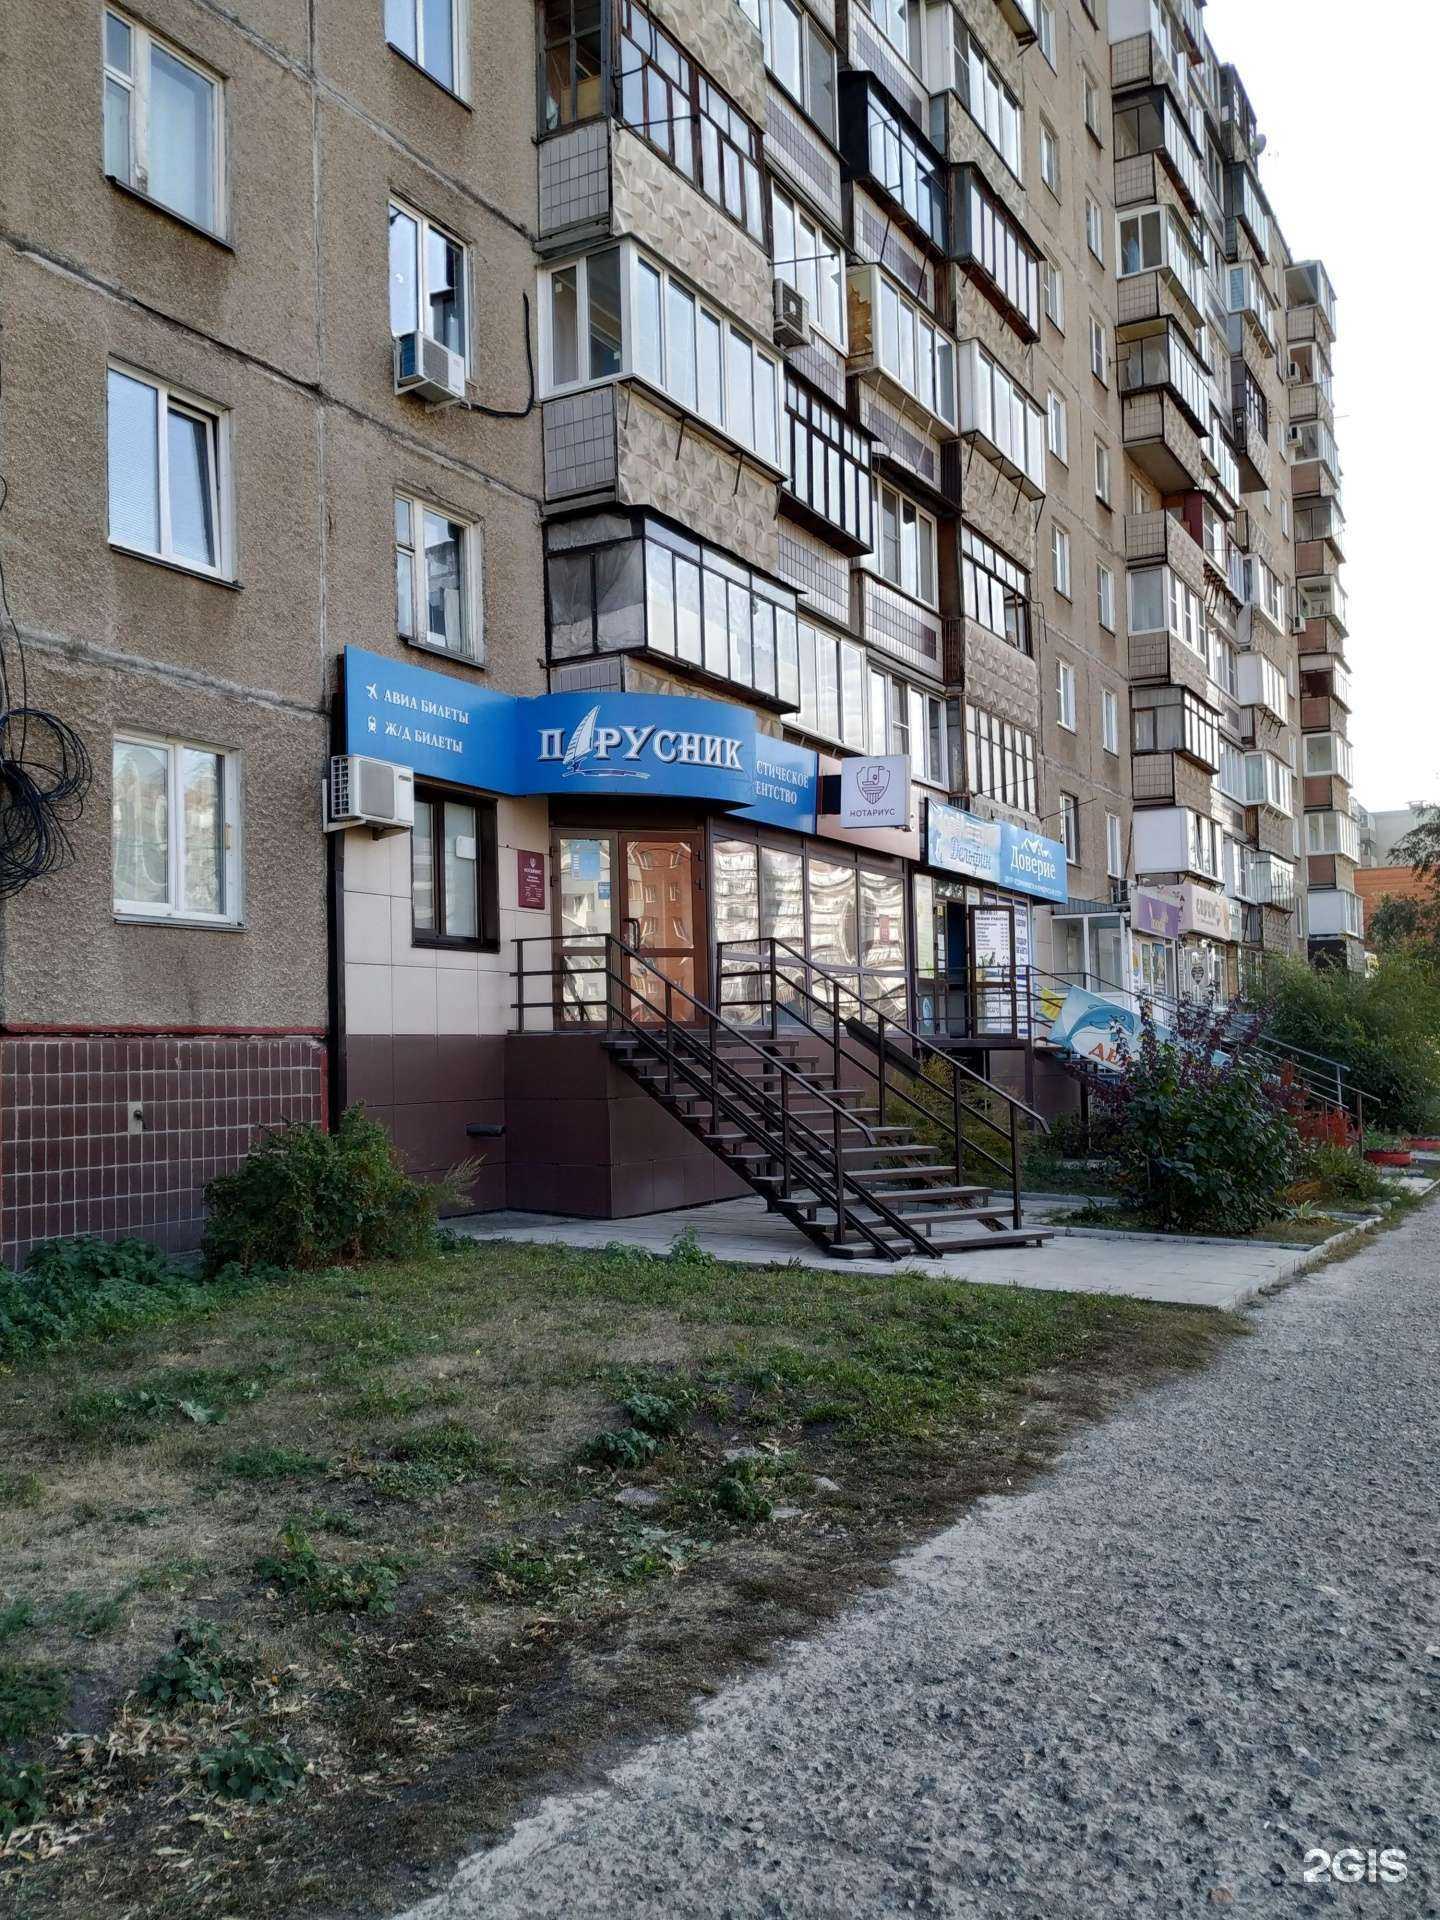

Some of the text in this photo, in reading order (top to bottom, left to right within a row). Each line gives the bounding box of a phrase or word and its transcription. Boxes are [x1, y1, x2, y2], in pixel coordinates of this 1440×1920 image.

[384, 689, 470, 725] АВИА БИЛЕТЫ
[384, 720, 463, 753] Ж/Д БИЛЕТЫ
[756, 760, 809, 789] СТИЧЕСКОЕ
[754, 780, 798, 806] ЕНТСТВО
[850, 808, 896, 817] НОТАРИУС
[1010, 844, 1056, 881] Доверие
